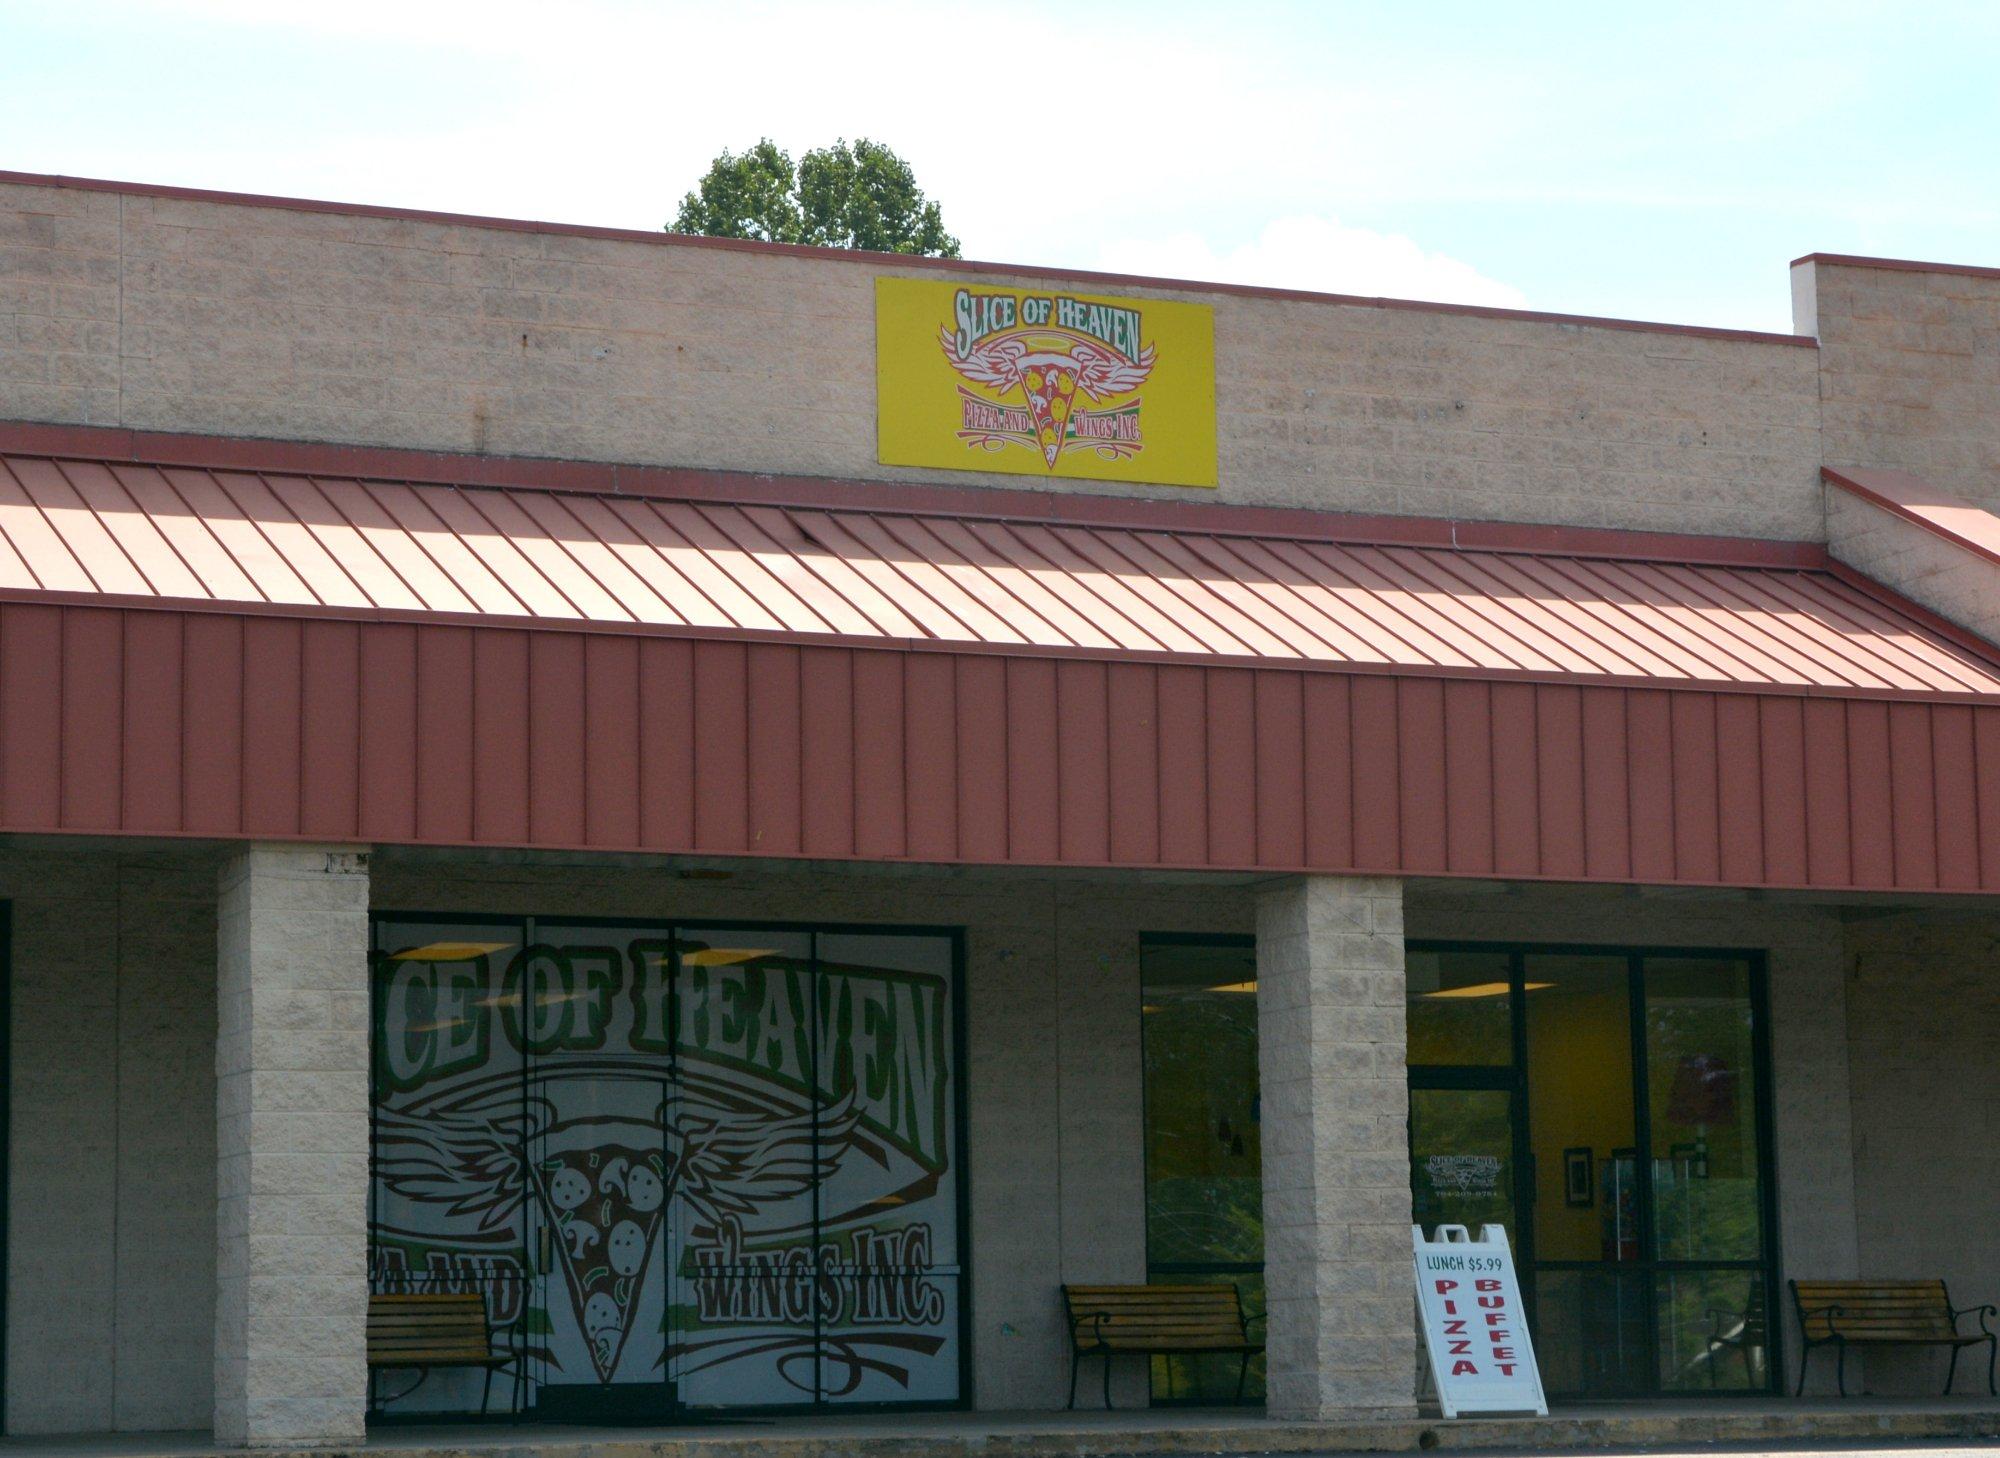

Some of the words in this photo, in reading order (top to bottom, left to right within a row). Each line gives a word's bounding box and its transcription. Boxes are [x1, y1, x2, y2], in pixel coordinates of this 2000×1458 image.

[955, 289, 1016, 360] SLICE
[1021, 297, 1052, 326] OF
[1056, 297, 1142, 364] HEAVEN
[963, 399, 1000, 431] PIZZA
[1003, 408, 1029, 432] AND
[1074, 408, 1113, 439] WINGS
[1116, 413, 1142, 440] INC.
[381, 953, 486, 1084] CE
[507, 950, 620, 1048] OF
[638, 946, 942, 1165] HEAVEN
[695, 1213, 843, 1324] WINGS
[852, 1223, 944, 1325] INC.
[1426, 1256, 1465, 1271] LUNCH
[1468, 1257, 1503, 1273] $5.99
[1434, 1279, 1479, 1376] PIZZA
[1474, 1279, 1518, 1377] BUFFET
